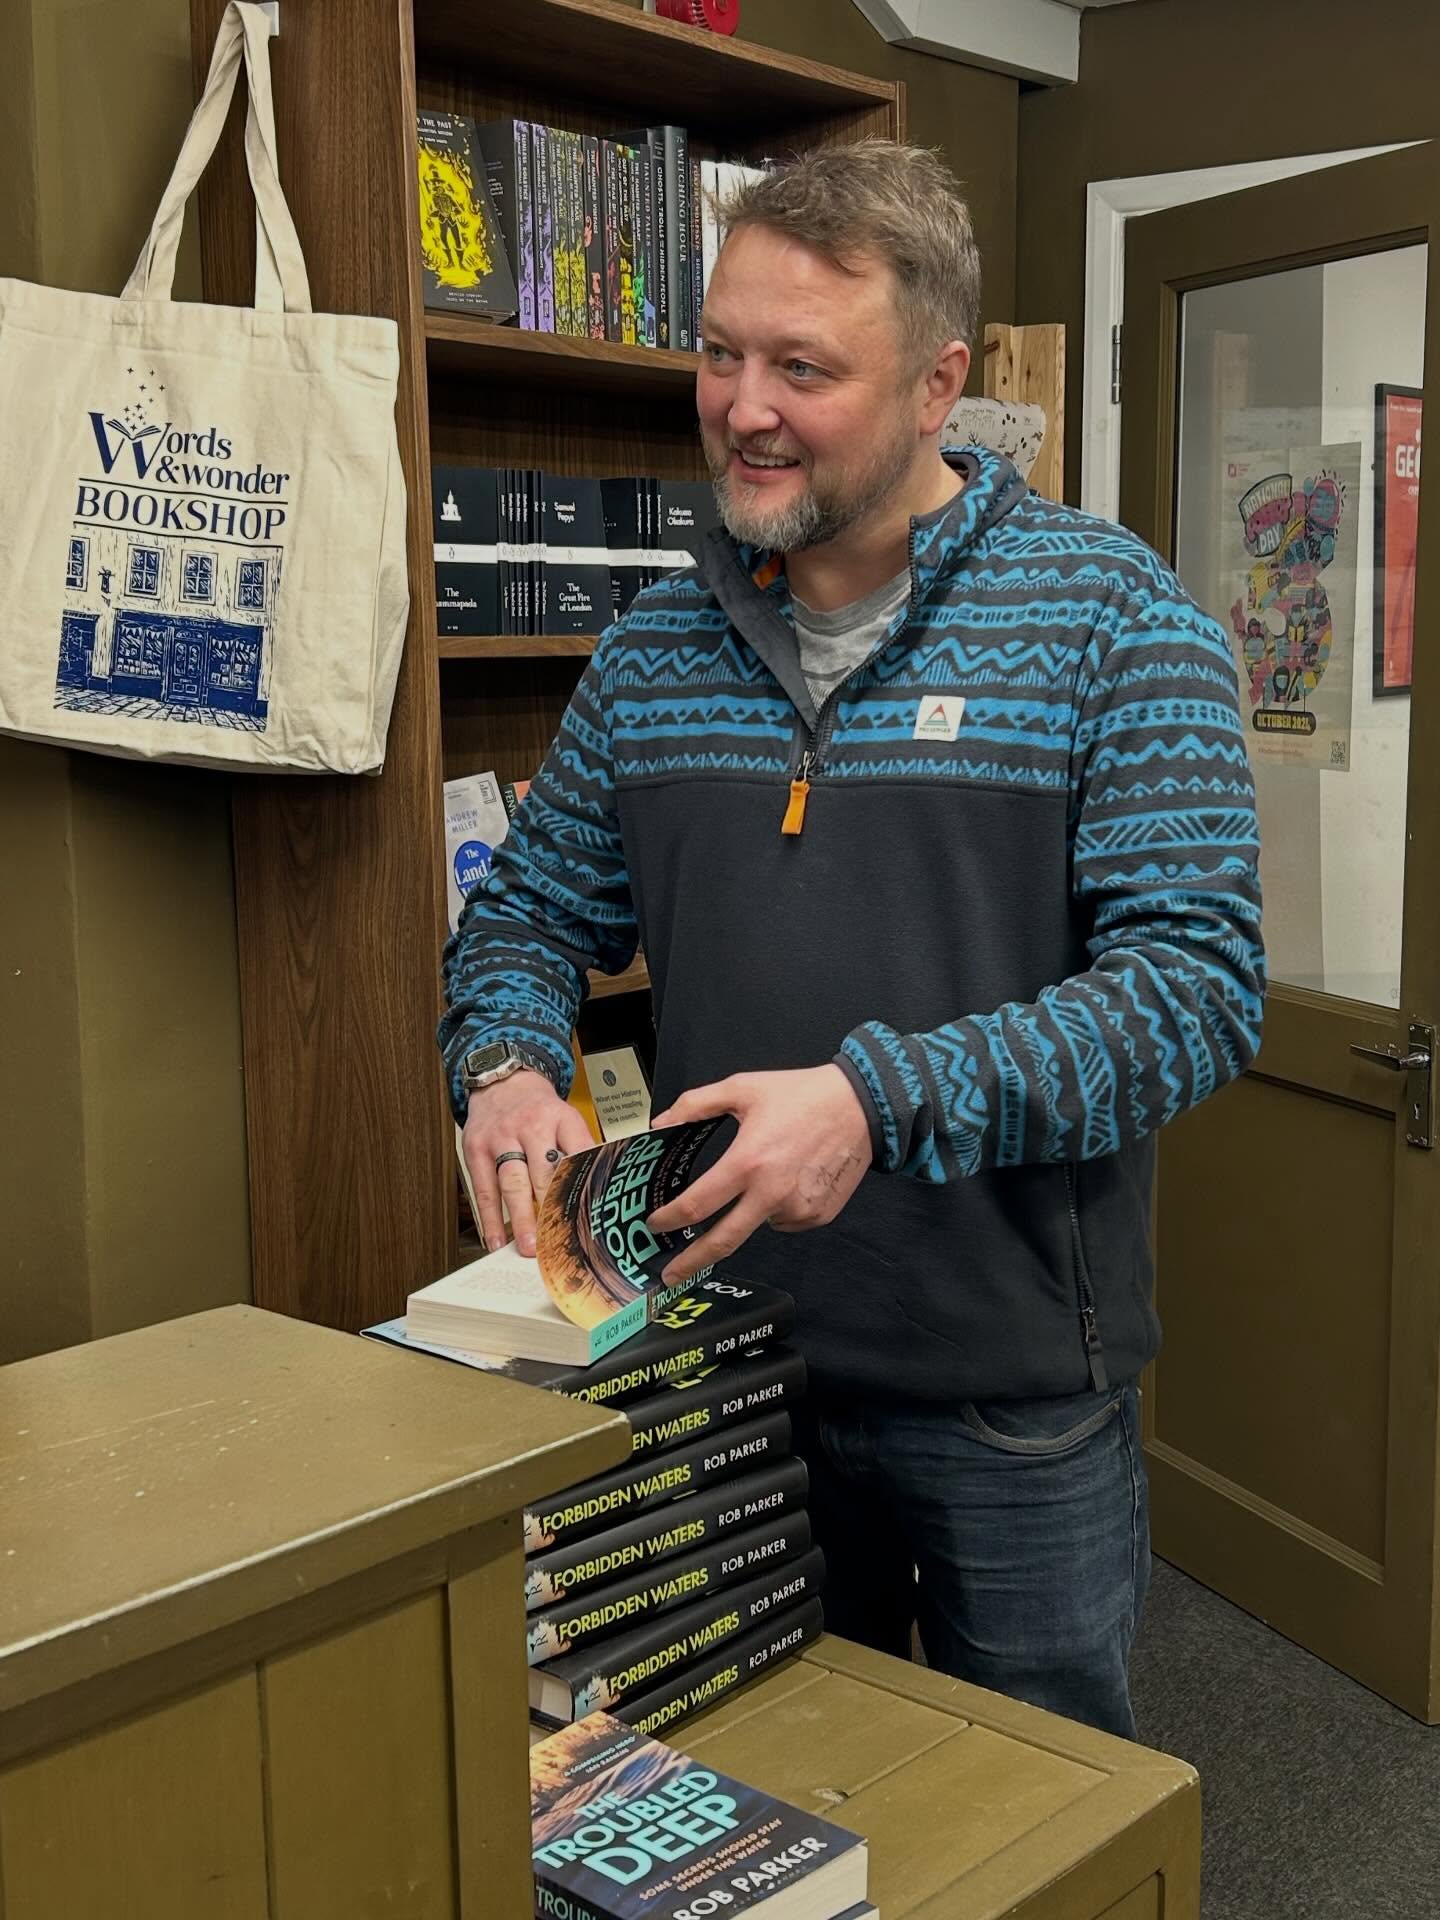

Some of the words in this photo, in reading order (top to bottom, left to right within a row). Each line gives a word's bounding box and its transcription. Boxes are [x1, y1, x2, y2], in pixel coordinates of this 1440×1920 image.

[677, 149, 687, 219] WITCHING
[679, 223, 688, 264] HOUR
[88, 412, 232, 479] Words
[75, 486, 286, 540] BOOKSHOP
[1260, 524, 1281, 553] DAY
[444, 587, 460, 597] The
[567, 582, 580, 592] The
[567, 602, 593, 612] London
[446, 809, 479, 824] ANDREW
[452, 820, 478, 834] MILLER
[455, 859, 488, 885] Land
[465, 849, 480, 860] The
[591, 1196, 605, 1241] THE
[603, 1134, 651, 1290] TROUBLED
[621, 1138, 665, 1265] DEEP
[656, 1276, 696, 1309] TROUBLED
[697, 1264, 715, 1283] DEEP
[703, 1281, 753, 1299] ROB
[606, 1327, 620, 1341] ROB
[621, 1308, 644, 1332] PARKER
[653, 1347, 704, 1380] WATERS
[716, 1339, 736, 1355] ROB
[739, 1323, 773, 1347] PARKER
[655, 1408, 710, 1442] WATERS
[722, 1398, 744, 1416] ROB
[747, 1383, 784, 1407] PARKER
[543, 1486, 631, 1534] FORBIDDEN
[634, 1464, 692, 1500] WATERS
[704, 1453, 726, 1472] ROB
[730, 1437, 769, 1463] PARKER
[553, 1543, 643, 1590] FORBIDDEN
[647, 1520, 705, 1556] WATERS
[718, 1509, 740, 1528] ROB
[745, 1492, 784, 1518] PARKER
[558, 1595, 648, 1643] FORBIDDEN
[651, 1568, 709, 1606] WATERS
[722, 1557, 744, 1575] ROB
[748, 1538, 787, 1565] PARKER
[608, 1645, 691, 1696] FORBIDDEN
[693, 1611, 740, 1654] WATERS
[750, 1596, 770, 1617] ROB
[772, 1576, 806, 1608] PARKER
[690, 1665, 739, 1706] WATERS
[749, 1651, 769, 1670] ROB
[770, 1628, 803, 1660] PARKER
[532, 1770, 718, 1869] TROUBLED
[575, 1791, 631, 1820] THE
[582, 1794, 740, 1886] DEEP
[640, 1880, 672, 1901] SOME
[672, 1856, 715, 1888] SECRETS
[715, 1830, 757, 1859] SHOULD
[758, 1818, 783, 1836] STAY
[677, 1868, 715, 1892] UNDER
[714, 1856, 737, 1874] THE
[736, 1838, 772, 1861] WATER
[673, 1890, 734, 1920] ROB
[731, 1836, 828, 1894] PARKER
